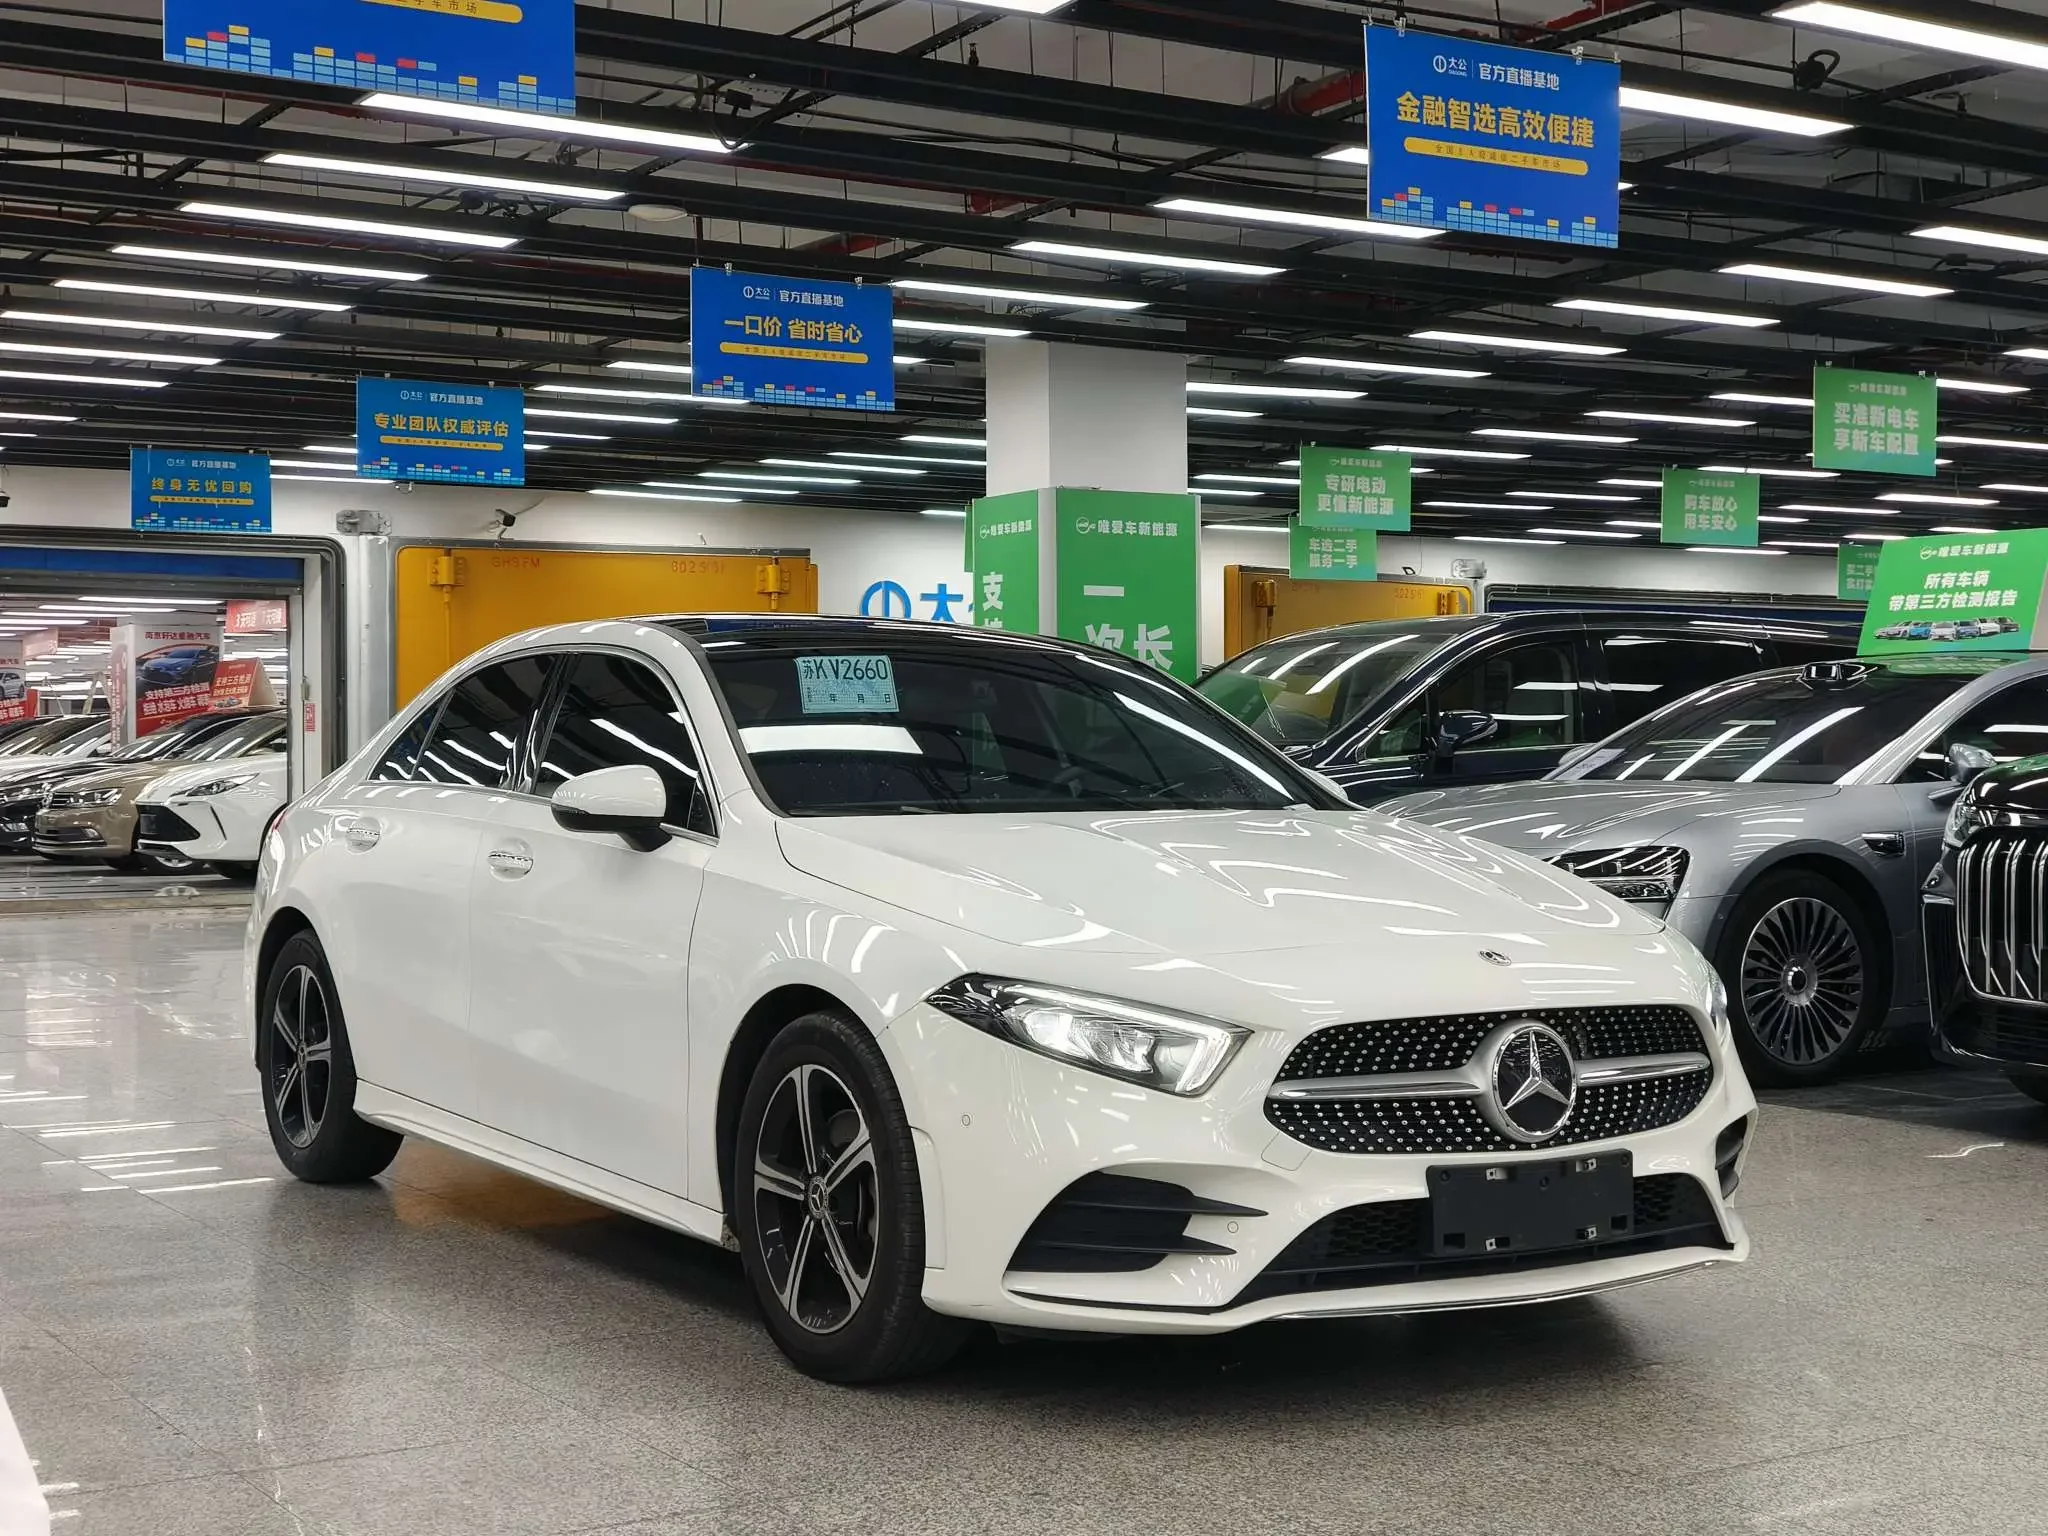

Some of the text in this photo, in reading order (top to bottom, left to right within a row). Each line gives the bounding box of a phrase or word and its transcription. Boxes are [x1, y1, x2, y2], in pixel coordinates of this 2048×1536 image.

[1448, 57, 1560, 91] 大公 官方直播基地
[1396, 90, 1594, 148] 金融智选高效便捷
[779, 289, 844, 308] 官方直播基地
[724, 315, 863, 344] 一口价 省时省心
[374, 412, 510, 438] 专业团队权威评估
[1097, 519, 1178, 537] 唯爱车新能源
[1924, 570, 1990, 590] 所有车辆
[919, 583, 973, 623] 大
[1888, 589, 2018, 612] 带第三方检测报告
[802, 659, 888, 680] 苏KV2660
